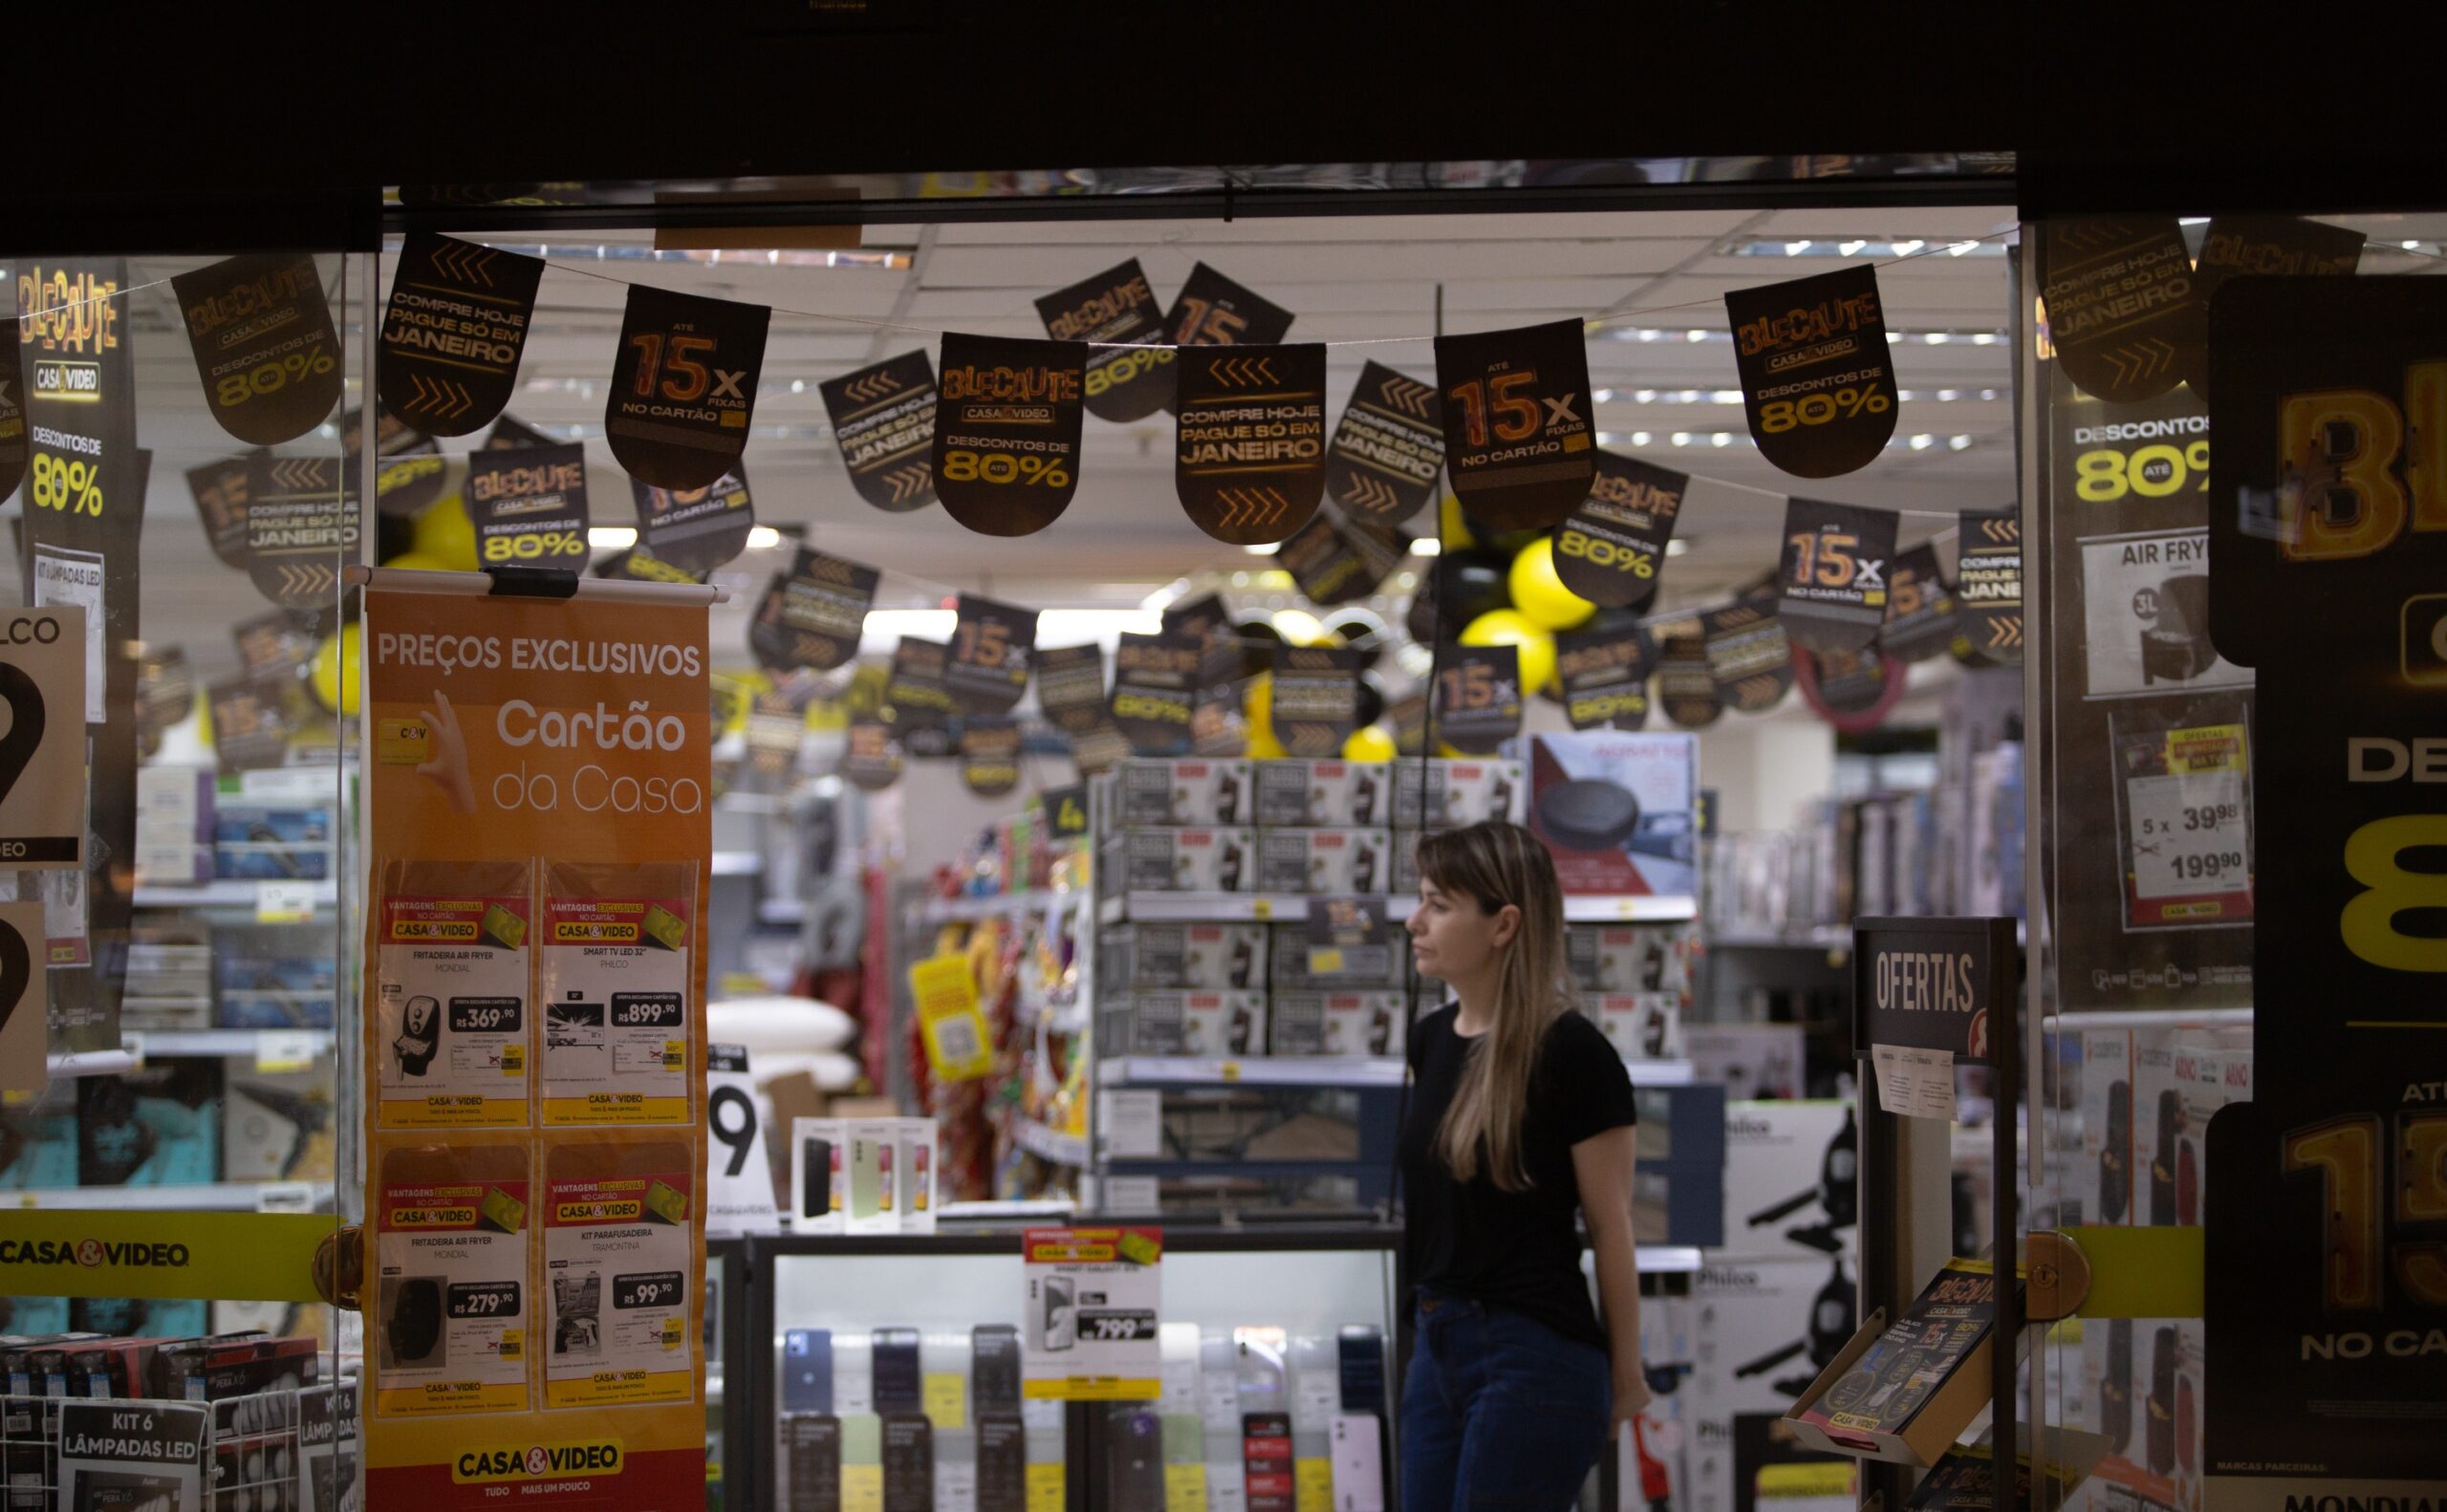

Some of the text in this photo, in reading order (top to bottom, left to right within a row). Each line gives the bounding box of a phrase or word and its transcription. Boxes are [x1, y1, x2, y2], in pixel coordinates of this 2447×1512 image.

[2043, 243, 2182, 296] COMPRE HOJE
[2047, 257, 2187, 318] PAGUE SÓ EM
[18, 266, 118, 355] BLECAUTE
[393, 292, 525, 327] COMPRE HOJE
[2053, 276, 2191, 338] JANEIRO
[389, 307, 521, 344] PAGUE SÓ EM
[672, 322, 695, 333] ATÉ
[1739, 292, 1878, 356] BLECAUTE
[211, 330, 326, 377] DESCONTOS DE
[384, 326, 515, 365] JANEIRO
[215, 345, 335, 407] 80%
[1487, 361, 1510, 373] ATÉ
[942, 365, 1080, 403] BLECAUTE
[1757, 367, 1882, 400] DESCONTOS DE
[621, 402, 717, 421] NO CARTÃO
[706, 398, 747, 409] FIXAS
[1180, 403, 1320, 424] COMPRE HOJE
[1759, 382, 1891, 434] 80%
[32, 425, 102, 456] DESCONTOS DE
[1180, 421, 1320, 443] PAGUE SÓ EM
[1545, 421, 1586, 437] FIXAS
[946, 434, 1071, 453] DESCONTOS DE
[1180, 438, 1320, 464] JANEIRO
[1461, 439, 1561, 468] NO CARTÃO
[1337, 433, 1438, 480] JANEIRO
[942, 450, 1070, 488] 80%
[2143, 463, 2171, 478] ATÉ
[32, 453, 103, 517] 80%
[249, 526, 358, 548] JANEIRO
[483, 529, 585, 562] 80%
[1557, 529, 1654, 579] 80%
[2122, 542, 2158, 566] AIR
[1787, 586, 1864, 603] NO CARTÃO
[378, 633, 701, 678] PREÇOS EXCLUSIVOS
[496, 699, 686, 752] Cartão
[492, 759, 703, 814] da Casa
[2143, 819, 2154, 834] 5
[388, 901, 435, 911] VANTAGENS
[551, 903, 597, 912] VANTAGENS
[395, 923, 475, 937] CASA&VIDEO
[558, 924, 635, 938] CASA&VIDEO
[413, 951, 494, 961] FRITADEIRA AIR FRYER
[600, 960, 629, 969] PHILCO
[435, 963, 471, 973] MONDIAL
[1876, 951, 1974, 1013] OFERTAS
[709, 1085, 756, 1177] 9
[388, 1188, 435, 1198] VANTAGENS
[552, 1183, 598, 1194] VANTAGENS
[394, 1209, 473, 1223] CASA&VIDEO
[560, 1203, 638, 1218] CASA&VIDEO
[411, 1237, 492, 1247] FRITADEIRA AIR FRYER
[581, 1229, 653, 1240] KIT PARAFUSADEIRA
[0, 1239, 189, 1267] CASA&VIDEO
[434, 1249, 469, 1259] MONDIAL
[593, 1242, 640, 1252] TRAMONTINA
[2301, 1331, 2372, 1361] NO
[344, 1393, 352, 1411] 6
[112, 1412, 153, 1431] KIT 6
[64, 1434, 196, 1460] LÂMPADAS LED
[458, 1444, 618, 1478] CASA&VIDEO
[2217, 1460, 2263, 1471] MARCAS
[484, 1480, 591, 1497] TUDO MAIS UM POUCO
